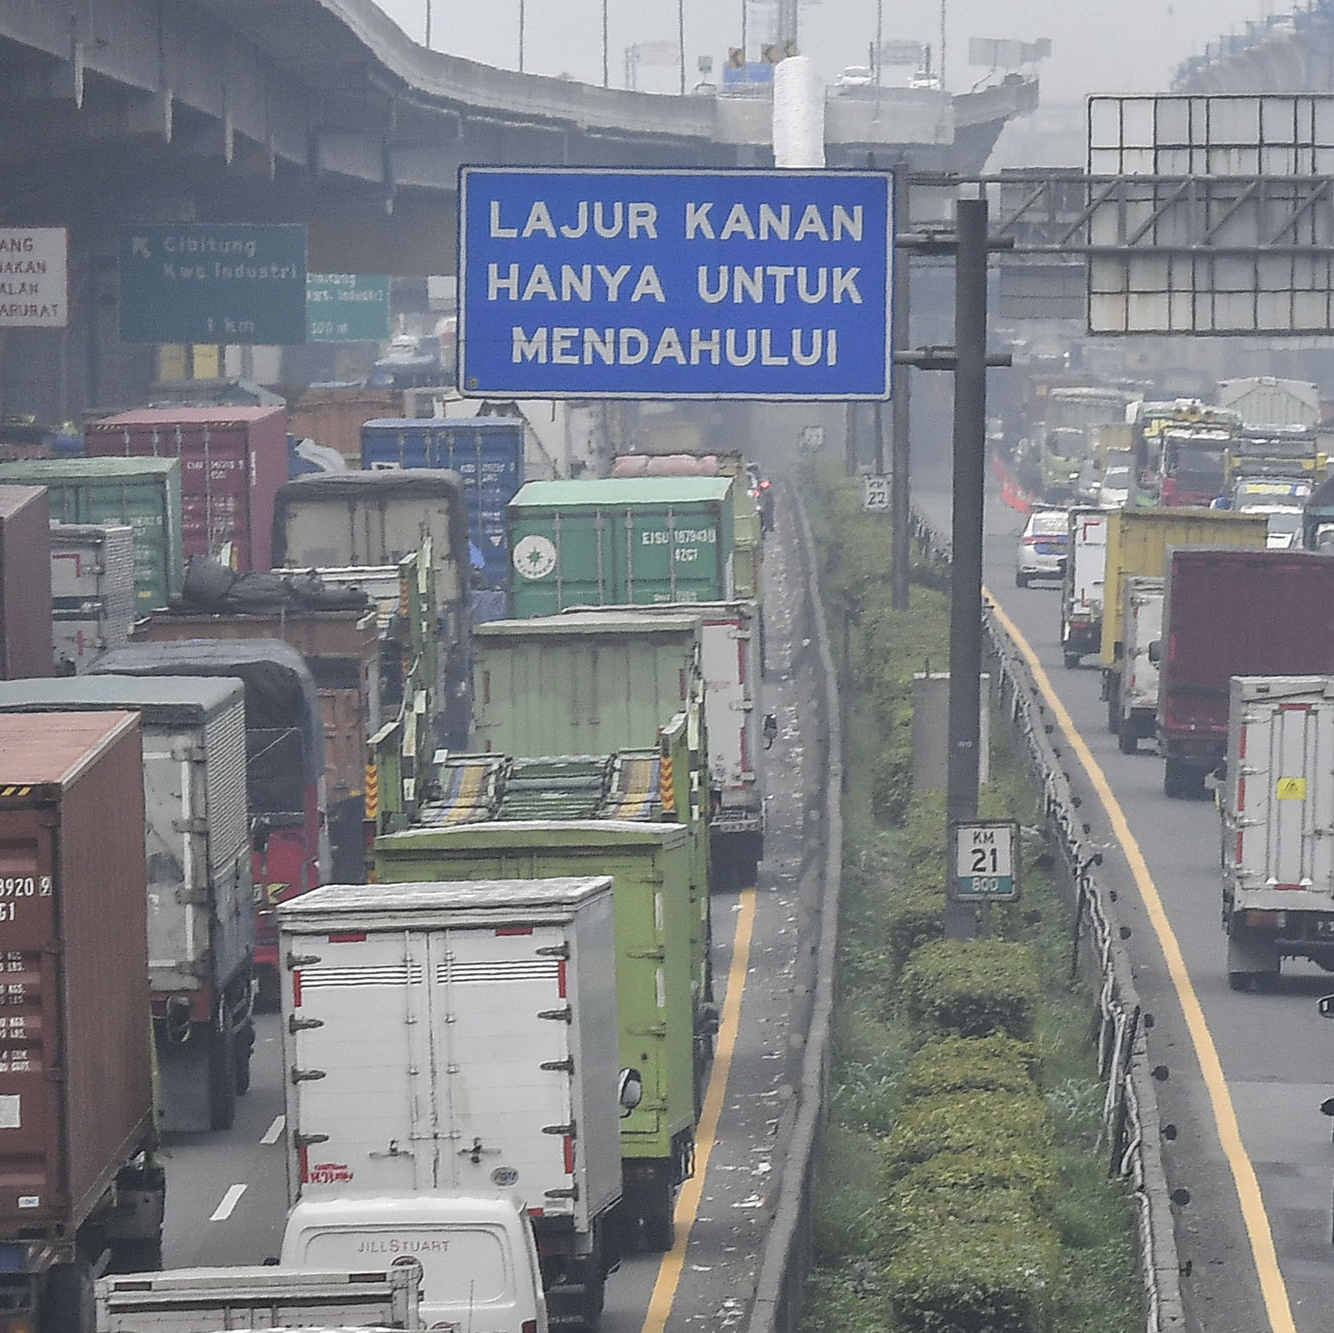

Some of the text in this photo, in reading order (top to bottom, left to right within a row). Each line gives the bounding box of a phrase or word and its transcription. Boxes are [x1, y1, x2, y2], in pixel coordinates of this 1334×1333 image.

[488, 200, 864, 242] LAJUR KANAN
[486, 263, 864, 305] HANYA UNTUK
[510, 325, 838, 367] MENDAHULUI
[972, 830, 996, 845] KM
[970, 847, 998, 873] 21
[41, 876, 51, 896] 9
